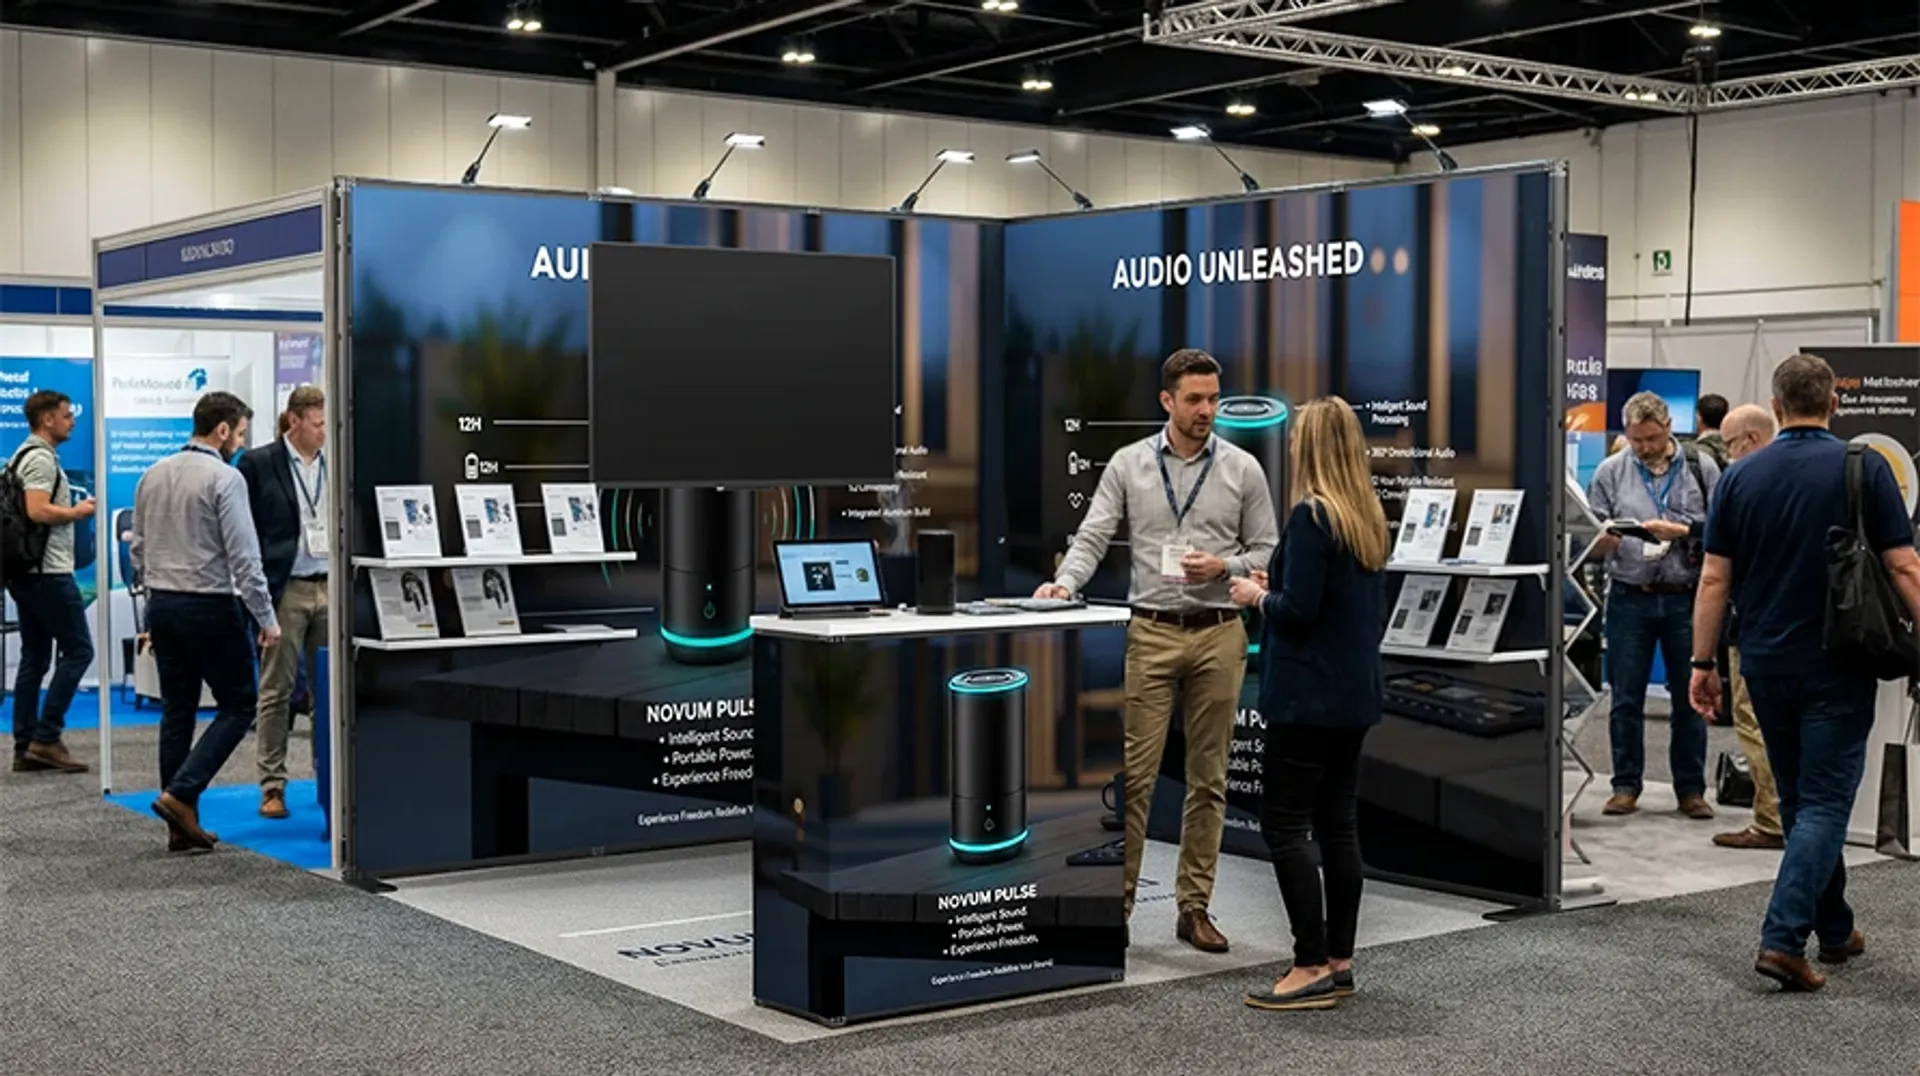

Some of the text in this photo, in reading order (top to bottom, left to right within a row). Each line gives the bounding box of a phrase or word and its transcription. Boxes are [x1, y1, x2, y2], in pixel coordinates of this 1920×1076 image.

[1113, 241, 1364, 289] AUDIO UNLEASHED
[1405, 399, 1428, 411] Sound
[458, 416, 482, 432] 12H
[647, 701, 712, 723] NOVUM
[668, 729, 720, 746] Intelligent
[672, 749, 717, 765] Portable
[661, 770, 720, 789] Experience
[938, 884, 1037, 910] NOVUM PULSE
[955, 911, 998, 925] Intelligent
[958, 924, 996, 939] Portable
[617, 931, 754, 960] NOVU
[950, 939, 998, 956] Experience
